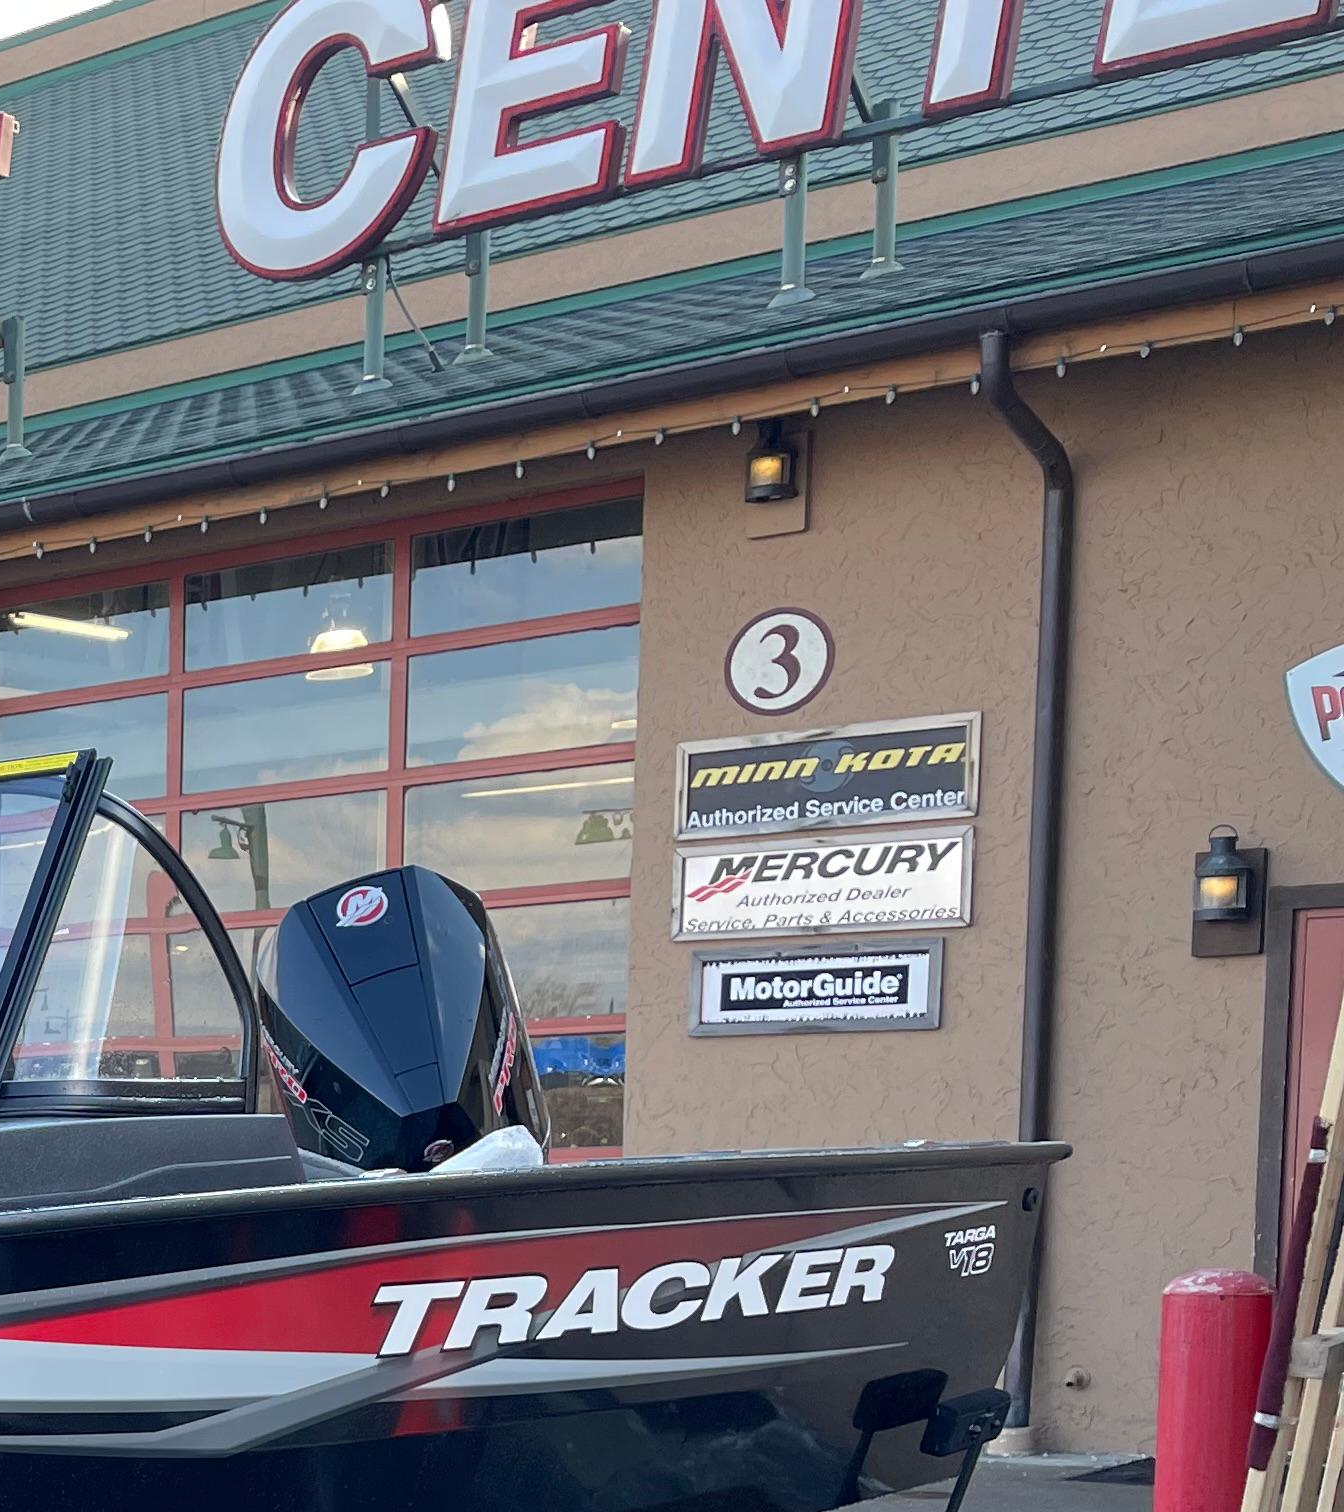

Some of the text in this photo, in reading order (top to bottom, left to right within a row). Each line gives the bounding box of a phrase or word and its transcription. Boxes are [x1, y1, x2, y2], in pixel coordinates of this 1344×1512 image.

[216, 0, 1342, 283] CEN
[753, 624, 801, 700] 3
[1310, 685, 1344, 741] P
[834, 742, 965, 774] KOTA
[687, 789, 966, 829] Authorized Service Center
[709, 841, 960, 885] MERCURY
[736, 886, 913, 908] Authorized Dealer
[686, 905, 959, 933] Service, Parts & Accessories
[729, 971, 901, 1001] MotorGuide
[782, 995, 899, 1008] Authorized Service Center
[944, 1225, 996, 1247] TARGA
[949, 1243, 995, 1277] V18
[372, 1244, 896, 1358] TRACKER
